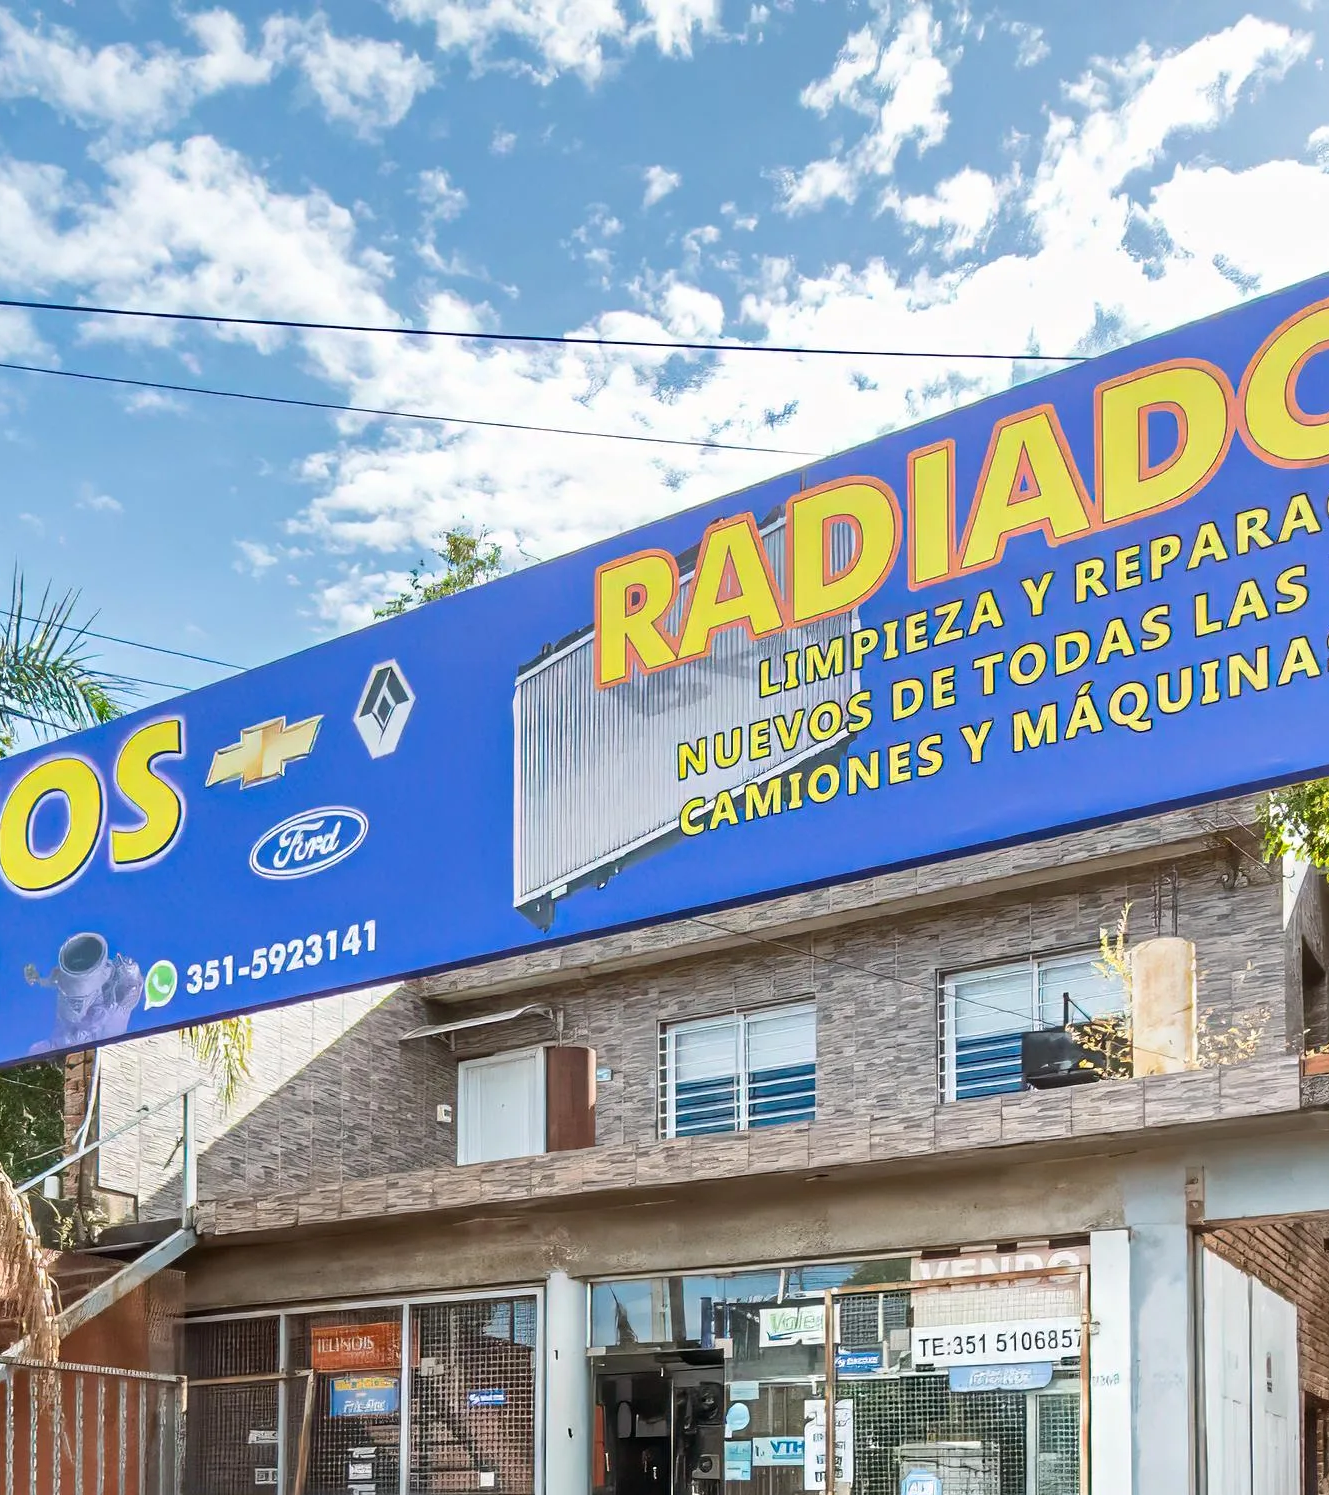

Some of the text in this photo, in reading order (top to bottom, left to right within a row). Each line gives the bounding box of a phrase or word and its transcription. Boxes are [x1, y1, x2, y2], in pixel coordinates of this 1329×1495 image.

[676, 690, 874, 781] NUEVOS
[890, 665, 957, 722] DE
[972, 604, 1173, 697] TODAS
[1194, 564, 1310, 638] LAS
[758, 589, 1006, 699] LIMPIEZA
[1022, 571, 1056, 617] Y
[678, 732, 946, 837] CAMIONES
[960, 720, 995, 765] Y
[273, 816, 341, 868] Ford
[186, 919, 377, 996] 351-5923141
[919, 1251, 1080, 1292] VENDO
[918, 1333, 987, 1358] TE:351
